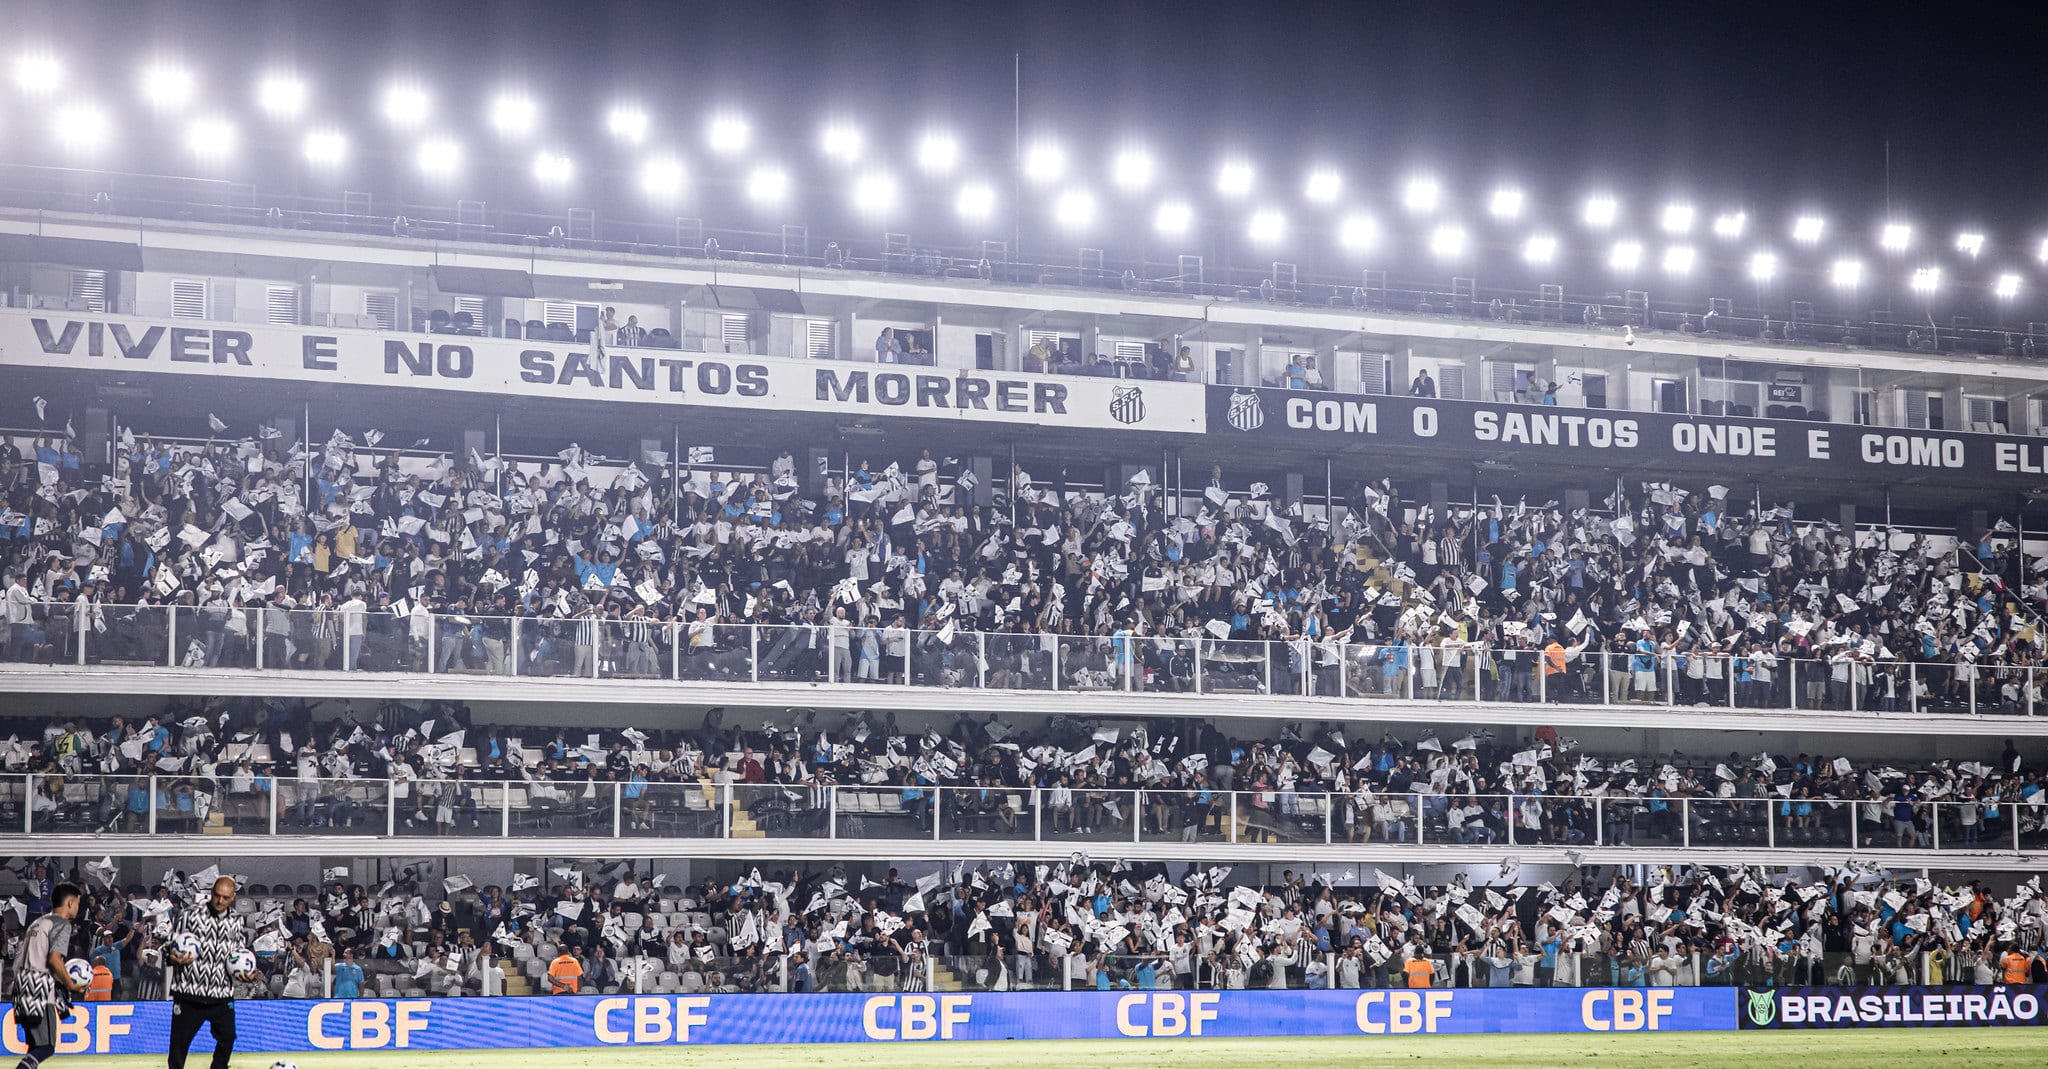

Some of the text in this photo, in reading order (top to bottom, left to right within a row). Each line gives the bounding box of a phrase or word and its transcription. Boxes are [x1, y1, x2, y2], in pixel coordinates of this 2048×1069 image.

[31, 318, 1068, 415] VIVER E NO SANTOS MORRER
[1286, 398, 2048, 474] COM O SANTOS ONDE E COMO EL
[307, 1001, 432, 1049] CBF
[593, 997, 711, 1043] CBF
[863, 995, 973, 1040] CBF
[1117, 993, 1220, 1036] CBF
[1355, 991, 1454, 1034] CBF
[1581, 989, 1675, 1031] CBF
[1781, 986, 2039, 1022] BRASILEIRÃO
